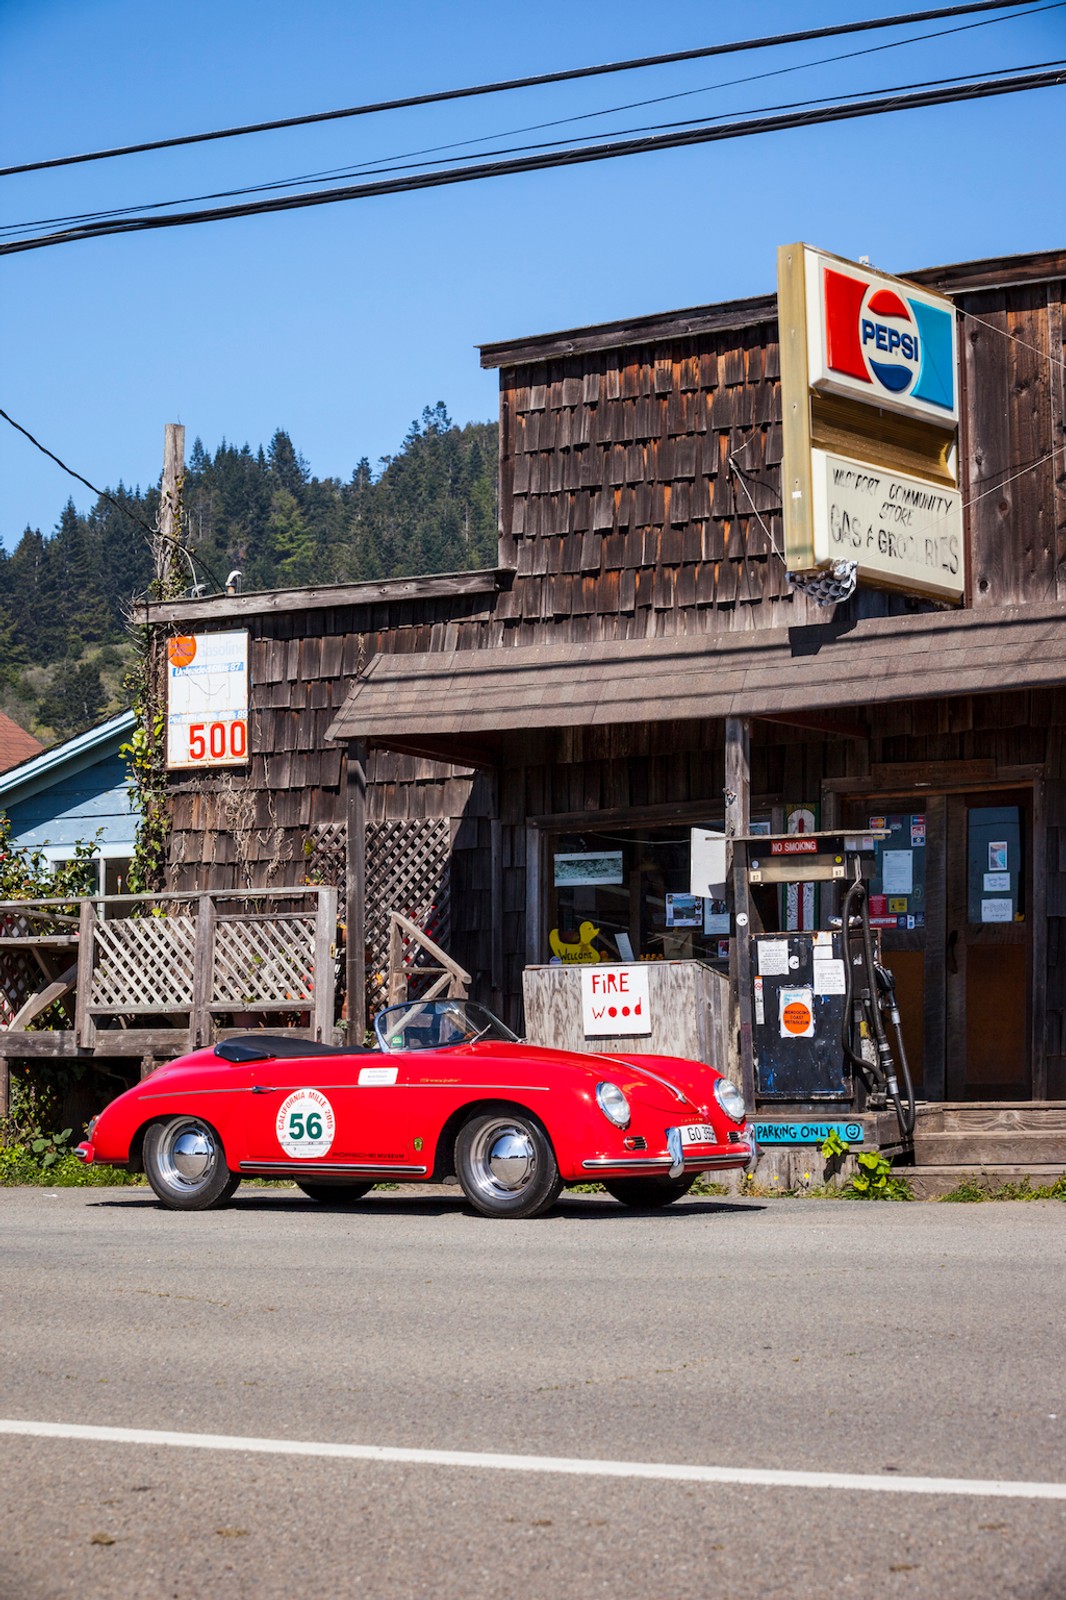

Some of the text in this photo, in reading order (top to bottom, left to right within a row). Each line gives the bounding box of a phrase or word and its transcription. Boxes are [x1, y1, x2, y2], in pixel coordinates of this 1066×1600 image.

[862, 319, 918, 362] PEPSI
[889, 483, 953, 515] COMMUNITY
[831, 504, 862, 548] GAS
[879, 502, 914, 527] STORE
[230, 663, 241, 671] 87
[238, 710, 248, 718] 89
[189, 720, 246, 760] 500
[772, 841, 817, 852] NO SMOKING
[558, 948, 593, 960] WELCOME
[278, 1091, 333, 1130] CALIFORNIA MILLE 2015
[288, 1112, 323, 1140] 56
[687, 1126, 702, 1142] GO
[757, 1125, 797, 1140] PARKING
